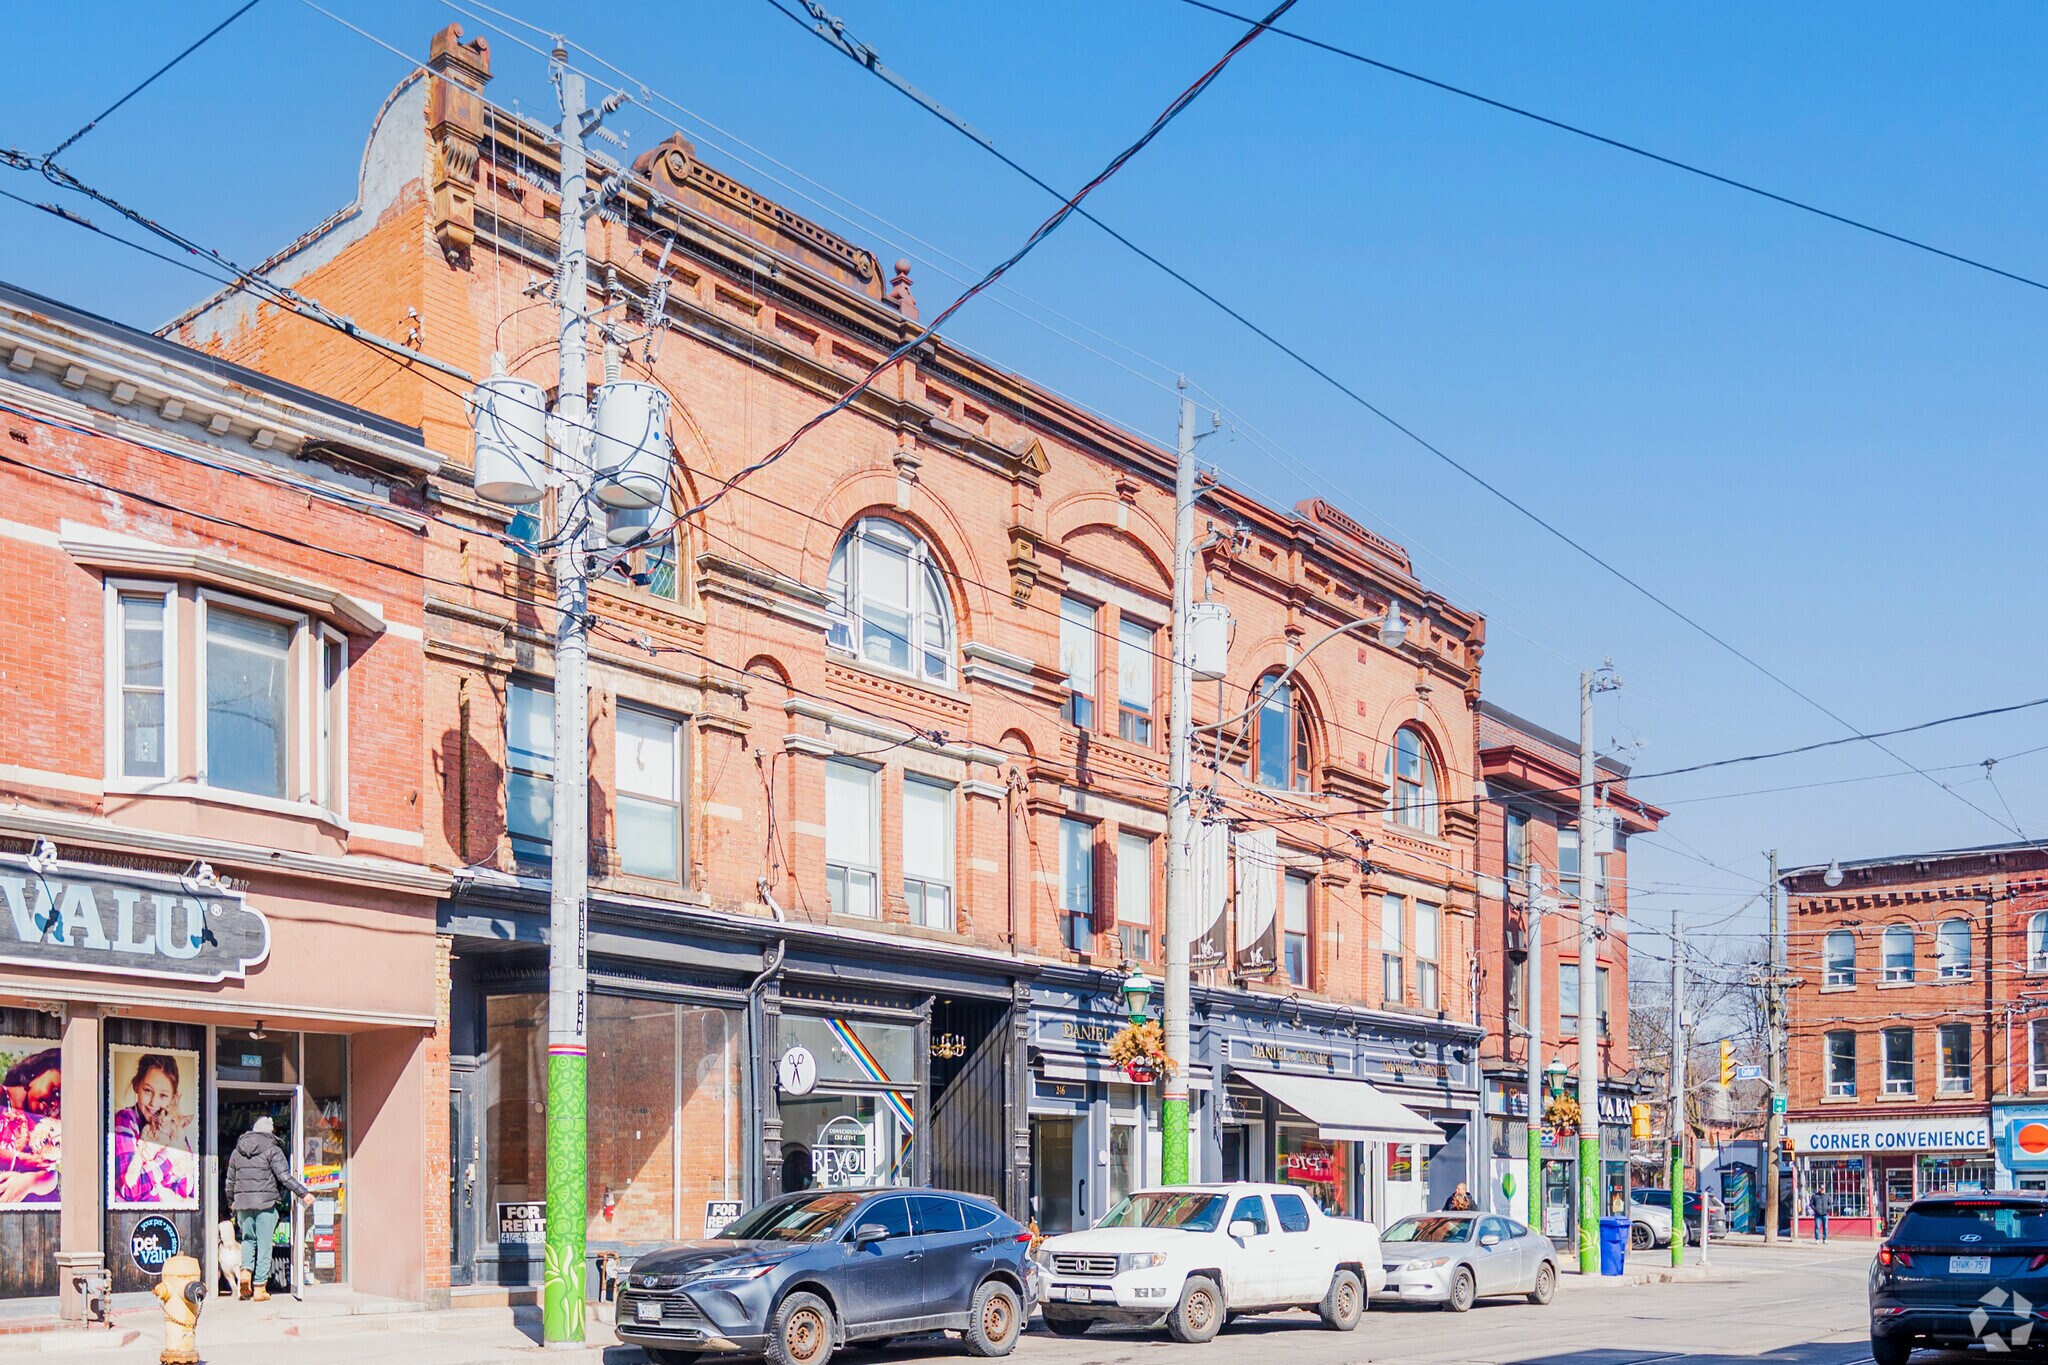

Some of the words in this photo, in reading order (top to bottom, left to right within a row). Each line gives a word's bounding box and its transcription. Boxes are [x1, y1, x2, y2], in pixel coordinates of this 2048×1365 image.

[0, 876, 207, 959] VALU
[1063, 1024, 1109, 1043] DANIEL
[243, 1056, 261, 1067] 240
[1251, 1044, 1288, 1061] DANIEL
[1299, 1050, 1335, 1066] DANIEL
[1382, 1061, 1411, 1074] DANIEL
[1422, 1065, 1449, 1078] DANIEL
[1056, 1085, 1066, 1095] 246
[1815, 1122, 1869, 1132] Cabbagetown
[1810, 1134, 1870, 1149] CORNER
[1875, 1130, 1986, 1148] CONVENIENCE
[507, 1206, 541, 1219] FOR
[713, 1204, 737, 1216] FOR
[502, 1218, 546, 1232] RENT
[133, 1234, 159, 1256] pet
[1974, 1260, 1989, 1269] 757
